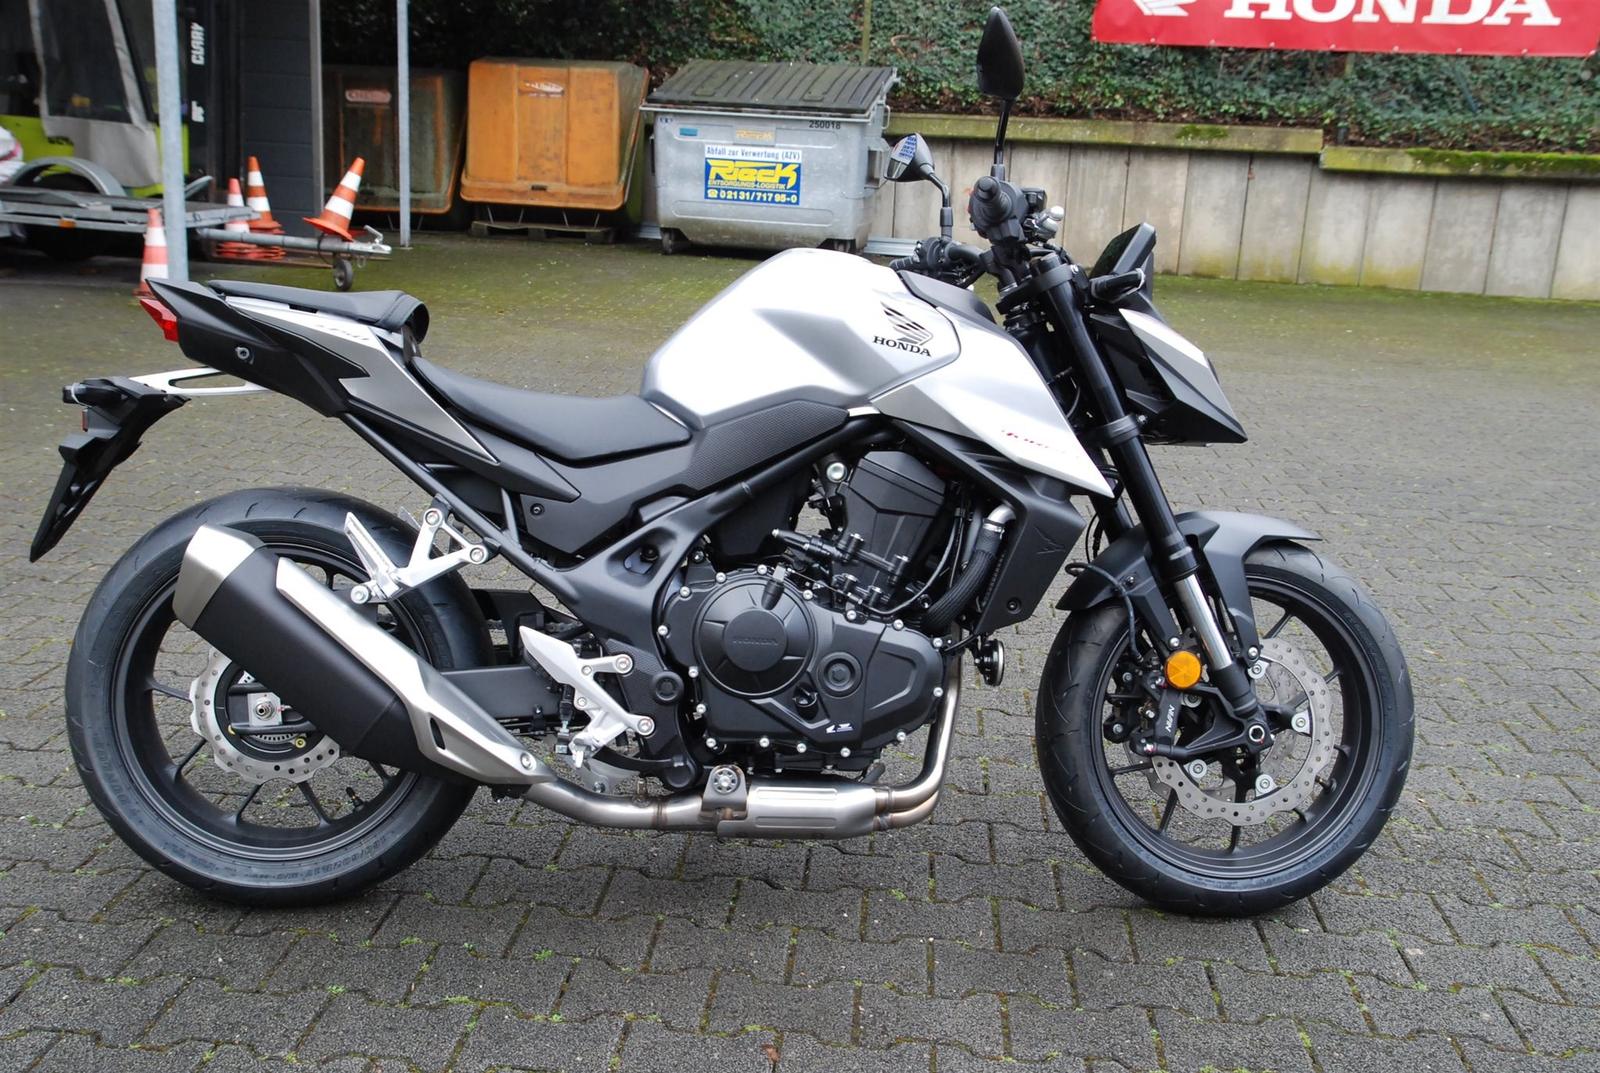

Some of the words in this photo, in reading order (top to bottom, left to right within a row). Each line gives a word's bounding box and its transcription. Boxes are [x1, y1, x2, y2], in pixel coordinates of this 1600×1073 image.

[1224, 0, 1561, 26] HONDA
[707, 146, 726, 156] Abfall
[728, 149, 739, 157] zur
[741, 149, 779, 160] Verwertung
[872, 336, 931, 357] HONDA
